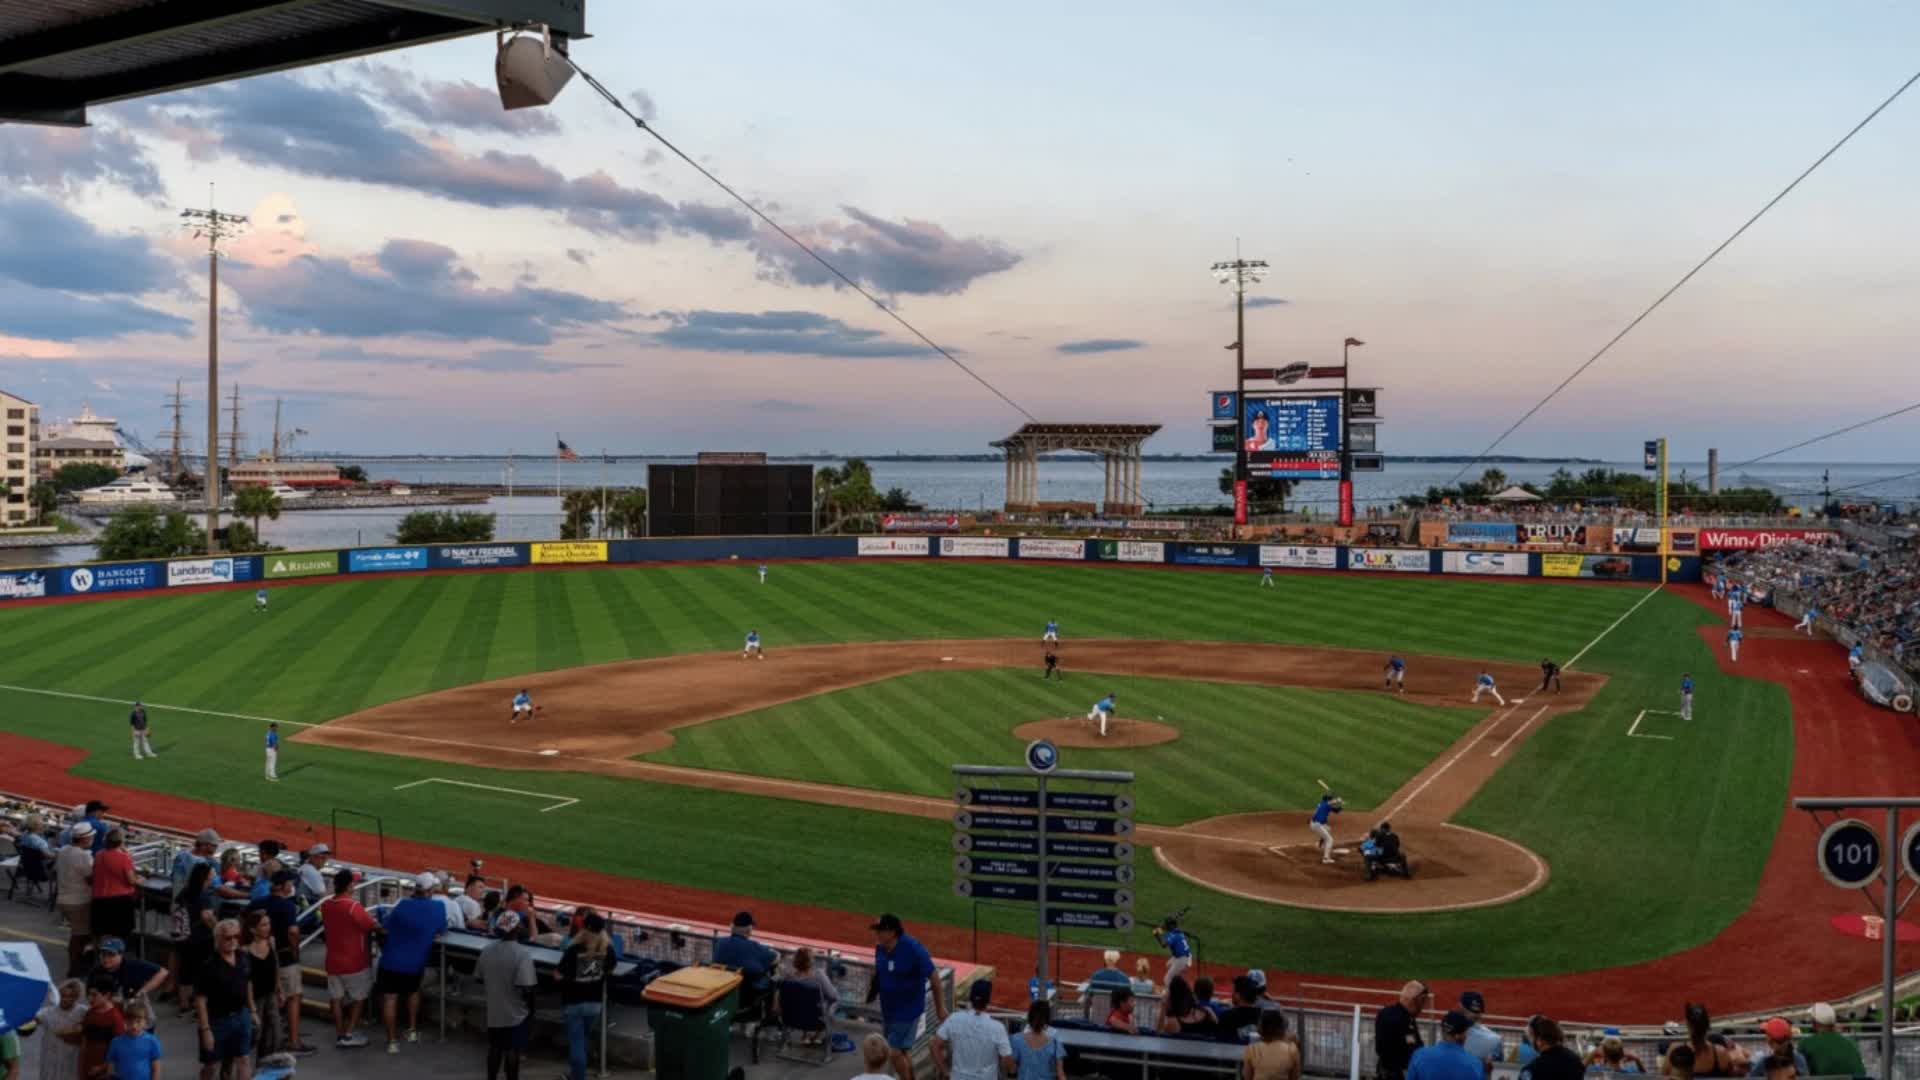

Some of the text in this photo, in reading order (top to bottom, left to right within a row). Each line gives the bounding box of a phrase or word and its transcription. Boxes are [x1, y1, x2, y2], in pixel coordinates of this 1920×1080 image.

[1525, 525, 1579, 538] TRULY
[1706, 533, 1748, 547] Winn
[897, 543, 927, 551] ULTRA
[97, 568, 146, 578] HANCOCK
[171, 565, 212, 577] Landrum
[97, 577, 145, 587] WHITNEY
[1833, 843, 1872, 865] 101
